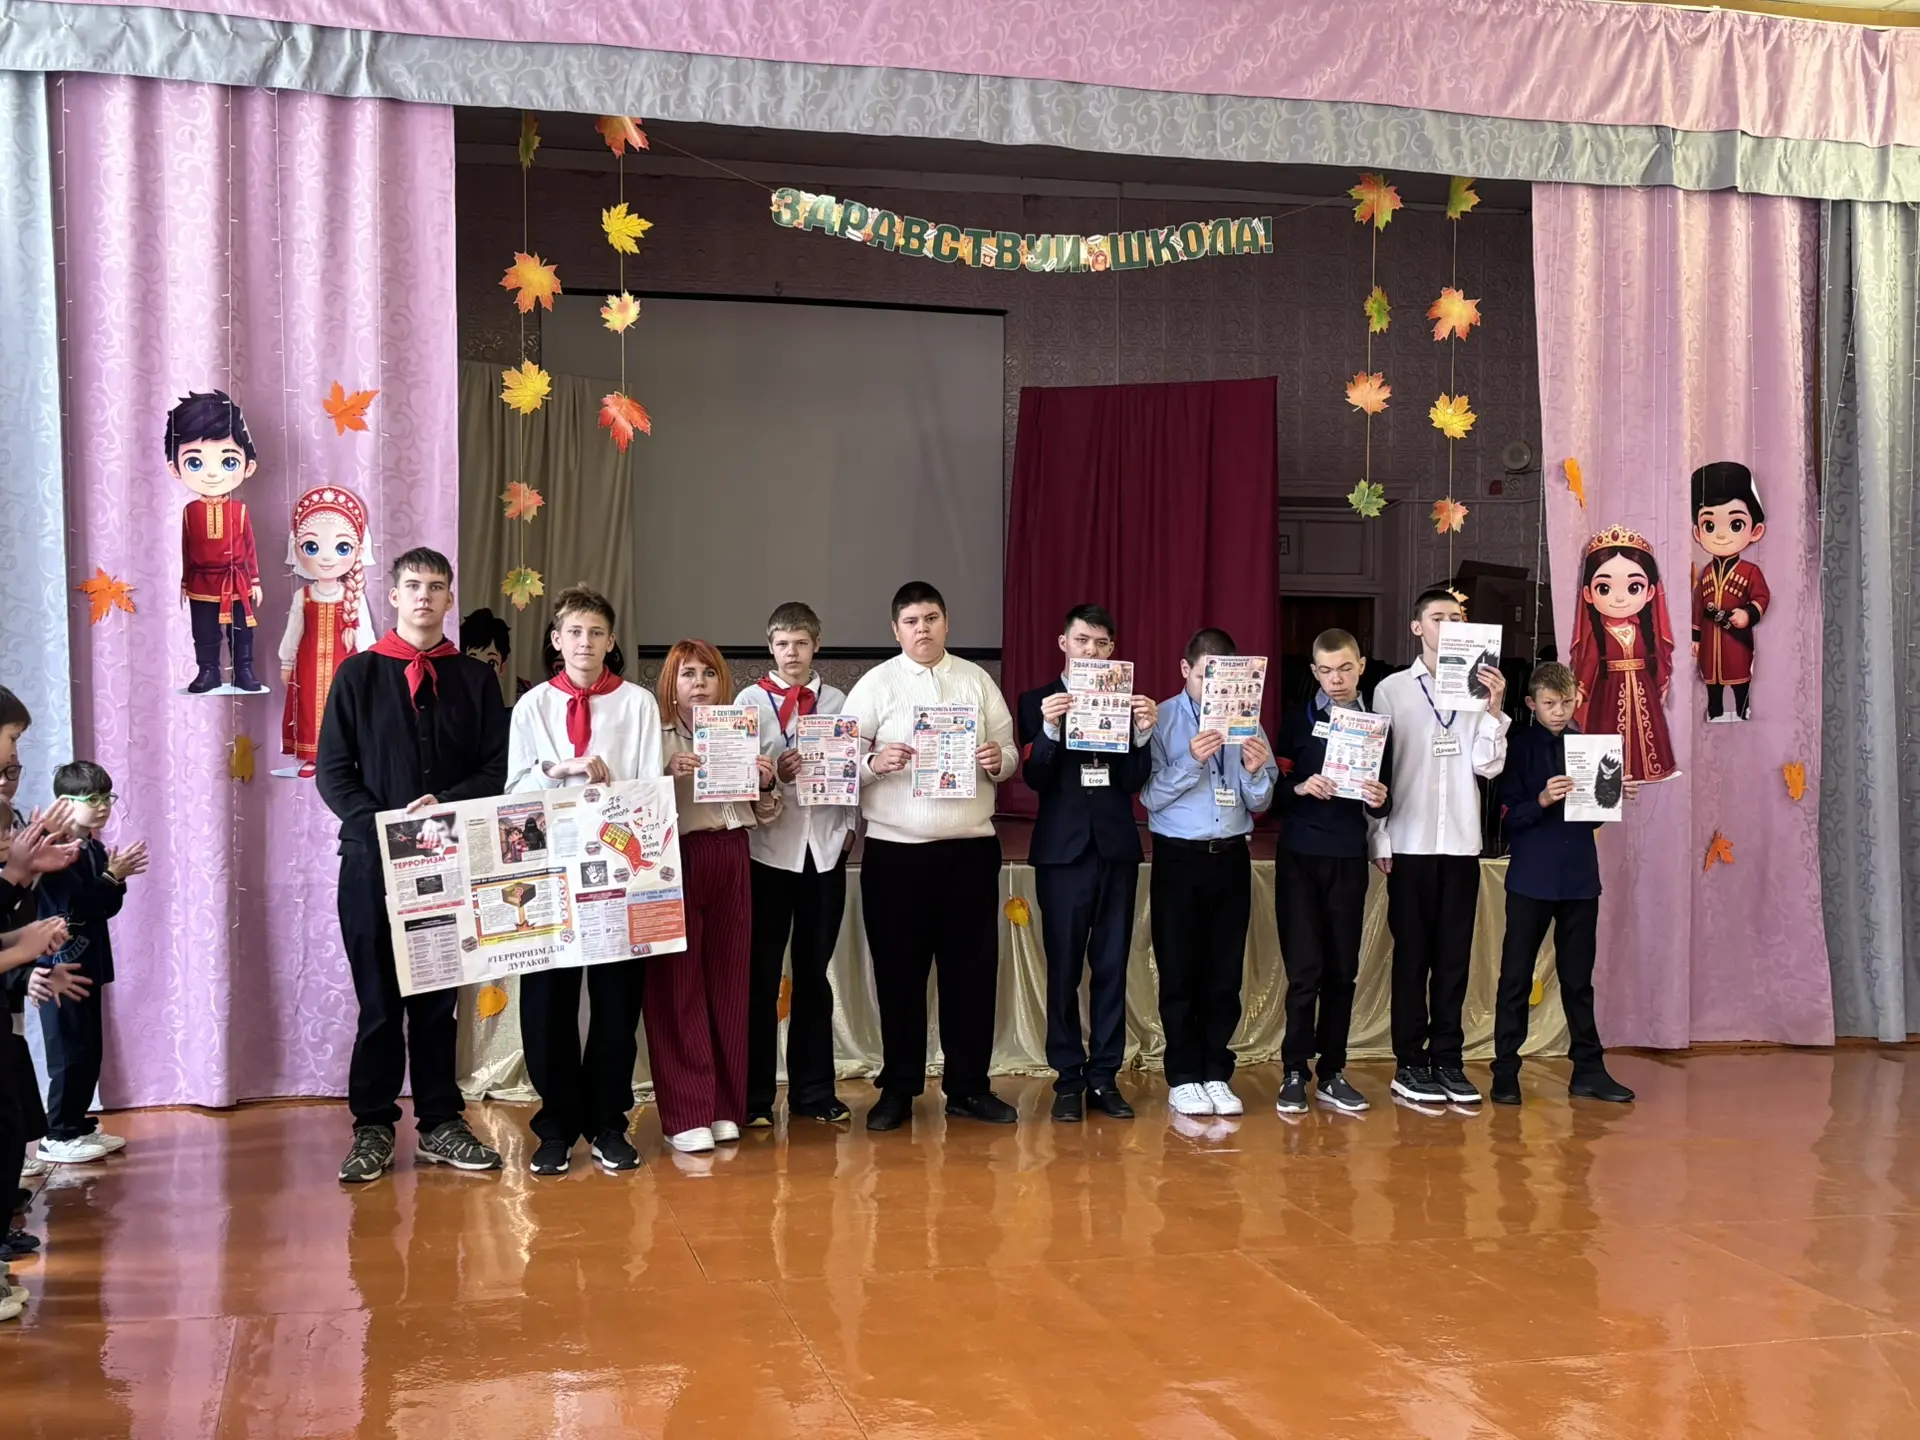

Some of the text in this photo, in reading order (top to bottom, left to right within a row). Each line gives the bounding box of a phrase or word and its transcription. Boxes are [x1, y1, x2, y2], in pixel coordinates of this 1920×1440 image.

[1108, 216, 1274, 270] ШКОЛА!
[393, 856, 446, 870] ТЕРРОРИЗМ
[487, 944, 565, 964] #ТЕРРОРИЗМ ДЛЯ
[507, 956, 550, 971] ДУРАКОВ
